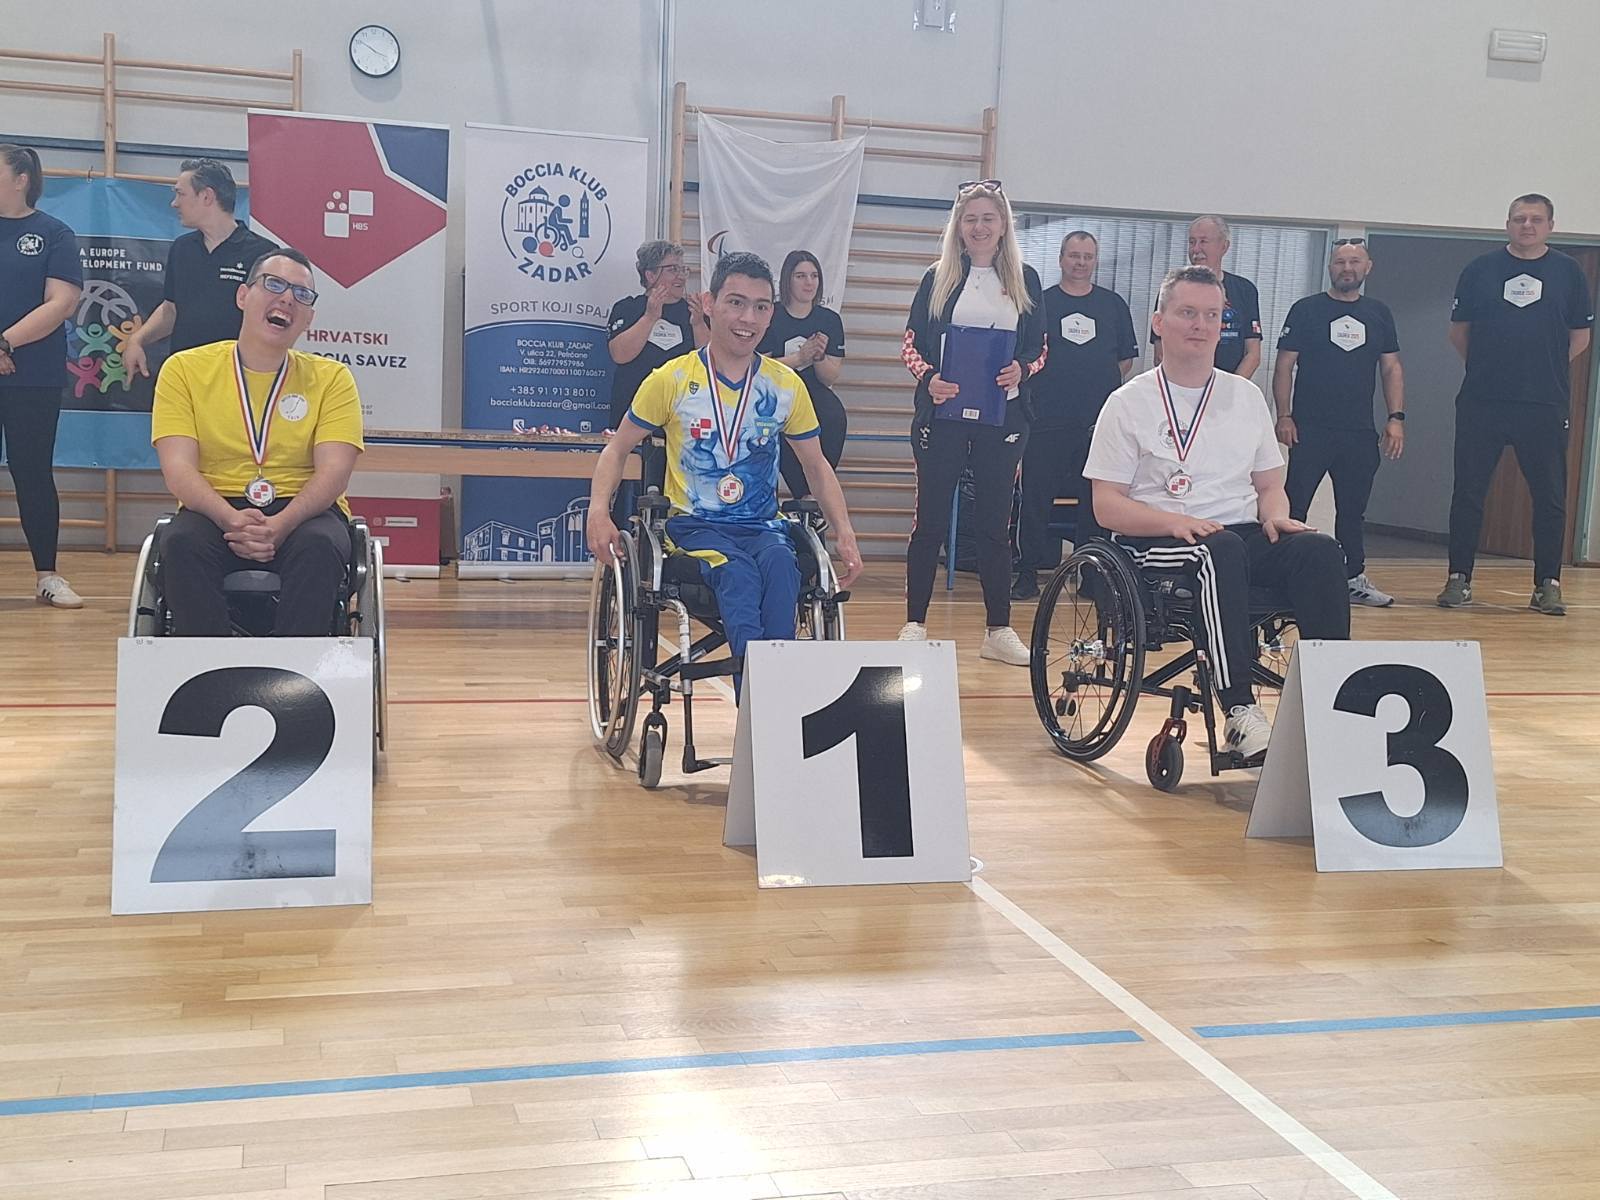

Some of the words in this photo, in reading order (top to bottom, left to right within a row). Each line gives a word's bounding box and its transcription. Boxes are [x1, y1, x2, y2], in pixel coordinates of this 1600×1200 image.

[505, 163, 564, 198] BOCCIA
[569, 166, 608, 201] KLUB
[89, 248, 126, 258] EUROPE
[80, 259, 132, 270] ELOPMENT
[136, 261, 163, 272] FUND
[518, 257, 593, 283] ZADAR
[490, 301, 539, 315] SPORT
[542, 301, 572, 314] KOJI
[306, 330, 388, 345] HRVATSKI
[517, 339, 546, 348] BOCCIA
[548, 340, 564, 348] KLUB
[527, 349, 544, 357] ulica
[356, 354, 407, 368] SAVEZ
[500, 366, 518, 374] IBAN:
[509, 386, 535, 395] +385
[537, 386, 548, 395] 91
[552, 387, 570, 396] 913
[572, 388, 596, 397] 8010
[1004, 433, 1020, 443] 4F
[801, 666, 914, 858] 1
[1332, 664, 1469, 848] 3
[150, 666, 336, 884] 2
